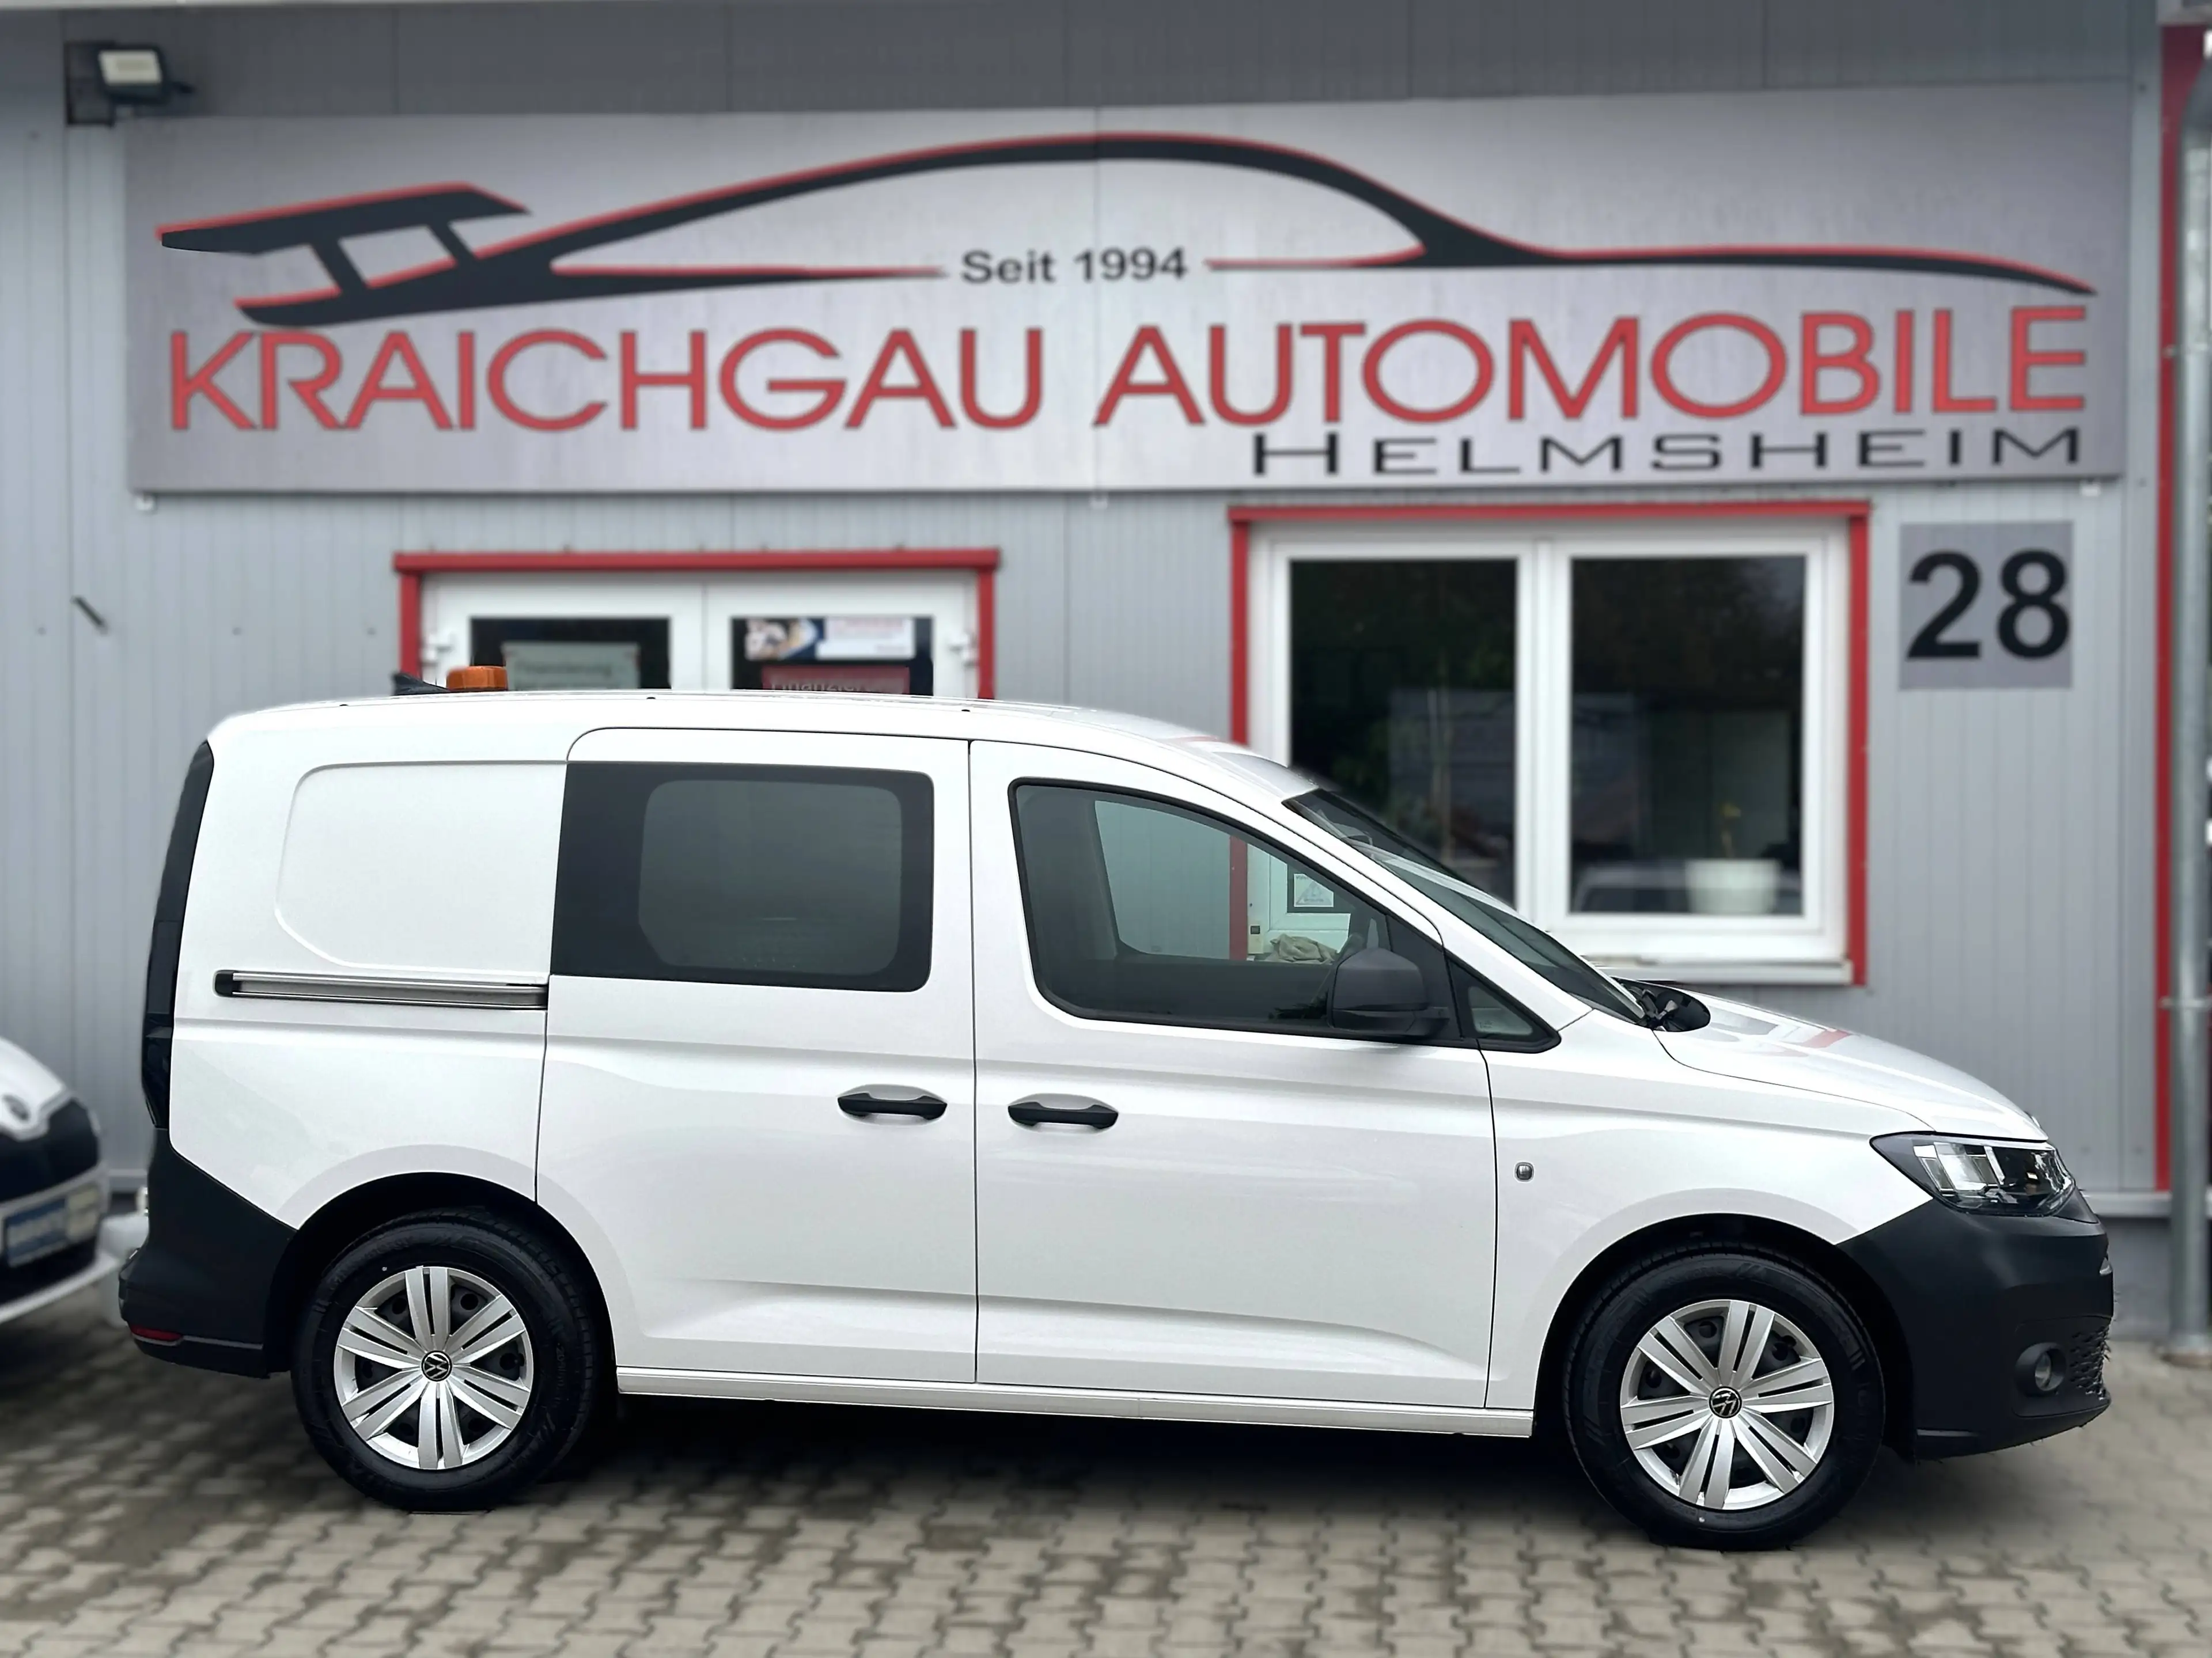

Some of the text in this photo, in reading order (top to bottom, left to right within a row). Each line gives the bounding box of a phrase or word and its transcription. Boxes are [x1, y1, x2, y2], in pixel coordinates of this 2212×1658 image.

[962, 247, 1188, 283] Seit 1994
[171, 306, 2086, 431] KRAICHGAU AUTOMOBILE
[1253, 426, 2081, 476] HELMSHEIM
[1906, 550, 2071, 660] 28
